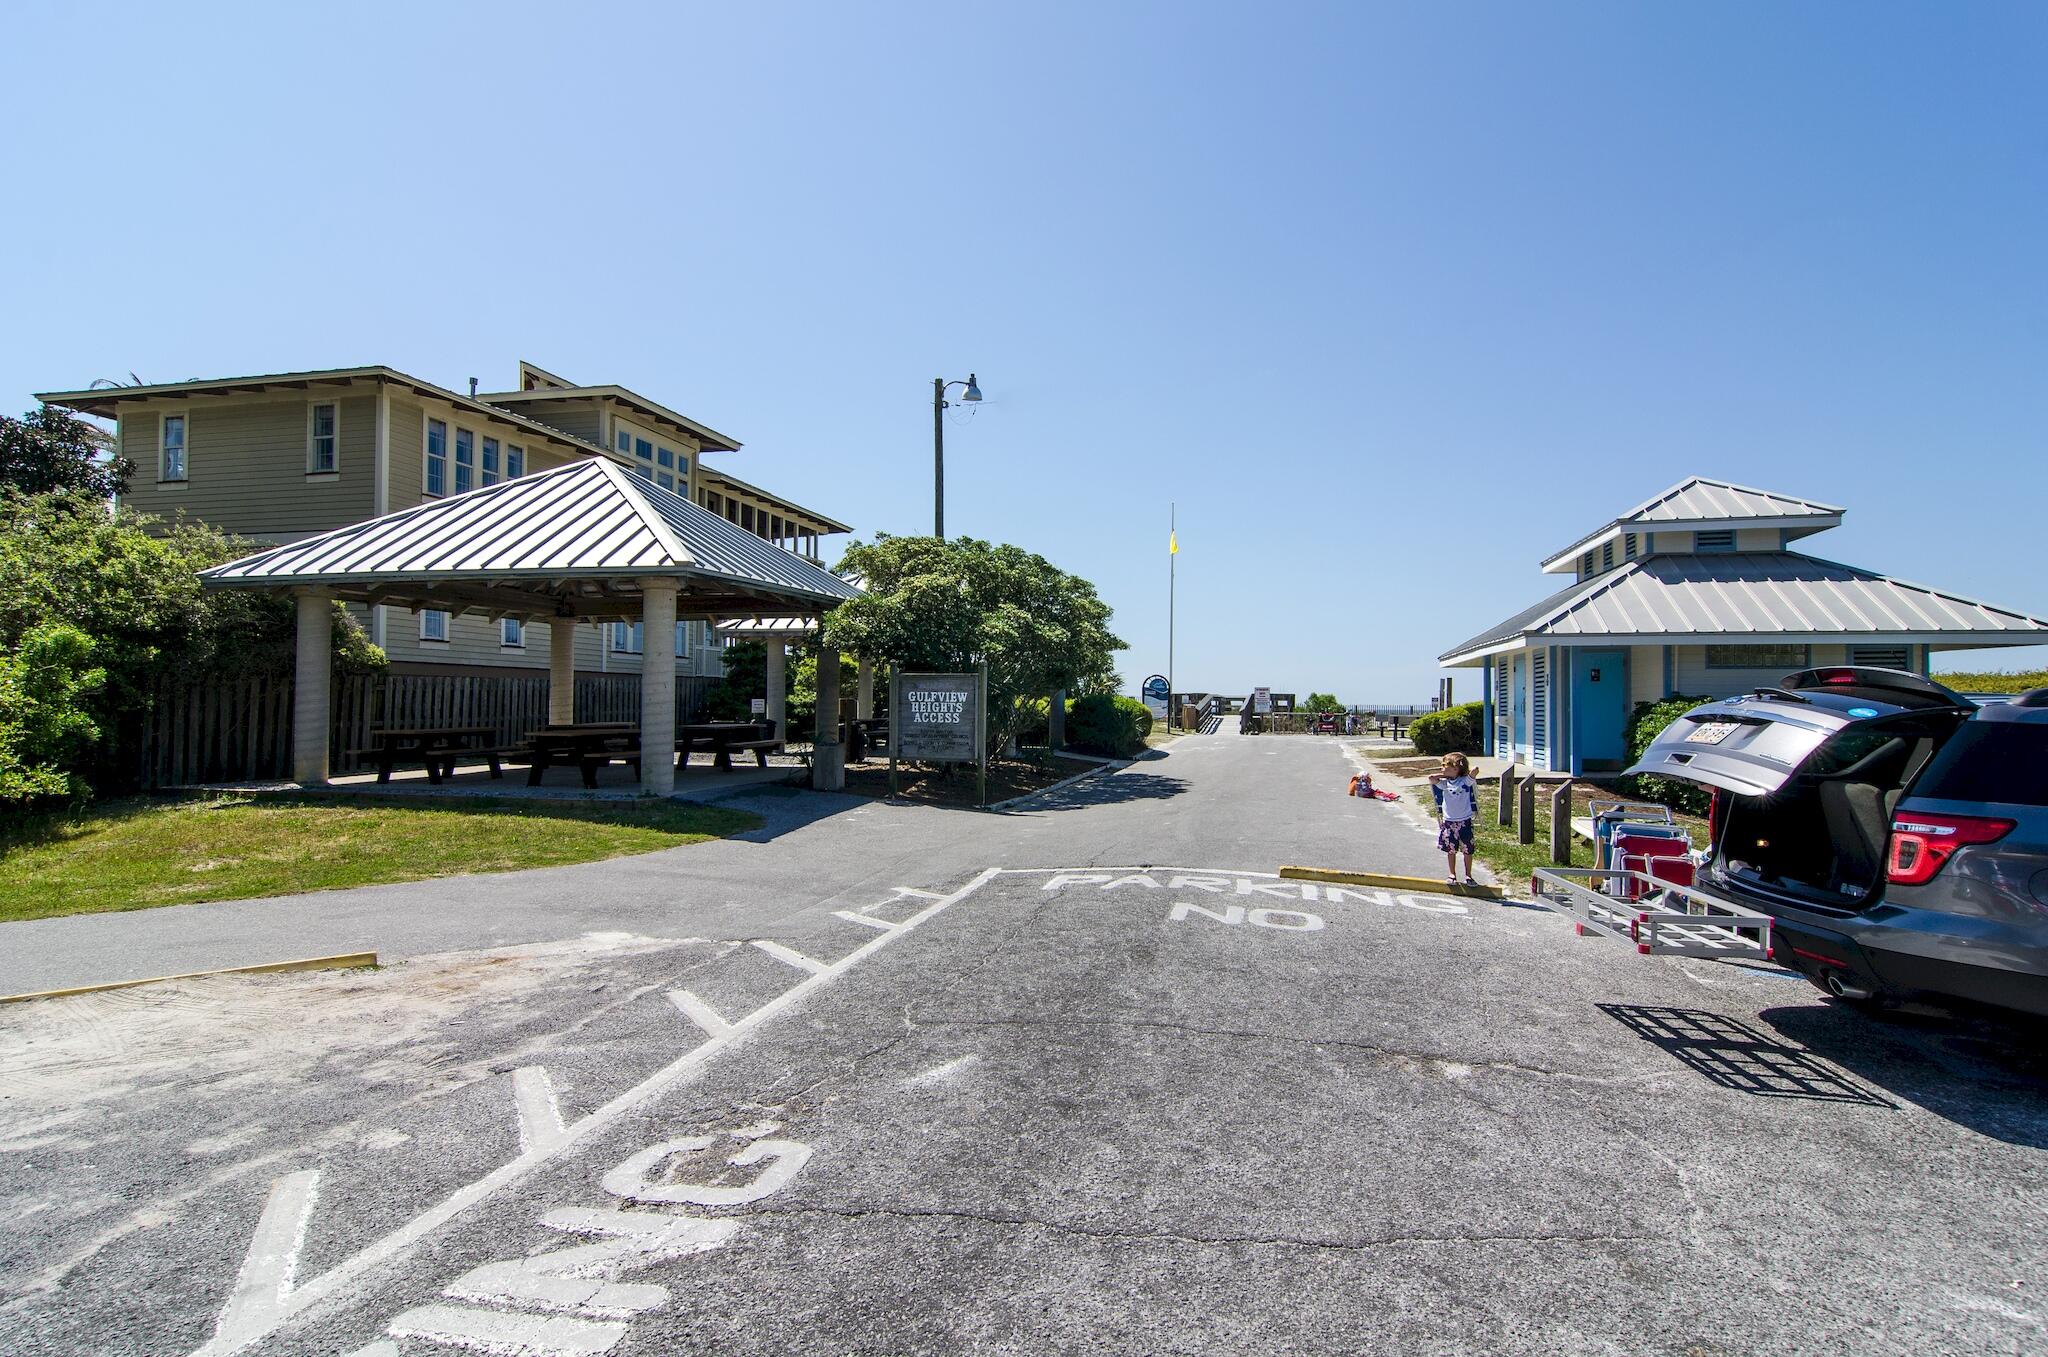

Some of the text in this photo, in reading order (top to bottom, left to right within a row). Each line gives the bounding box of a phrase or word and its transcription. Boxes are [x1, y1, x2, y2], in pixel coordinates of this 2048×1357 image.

[908, 691, 968, 703] GULFVIEW
[911, 702, 963, 713] HEIGHTS
[913, 712, 960, 723] ACCESS
[1042, 873, 1469, 914] PARKING
[1169, 902, 1325, 932] NO
[342, 1120, 815, 1357] ING
